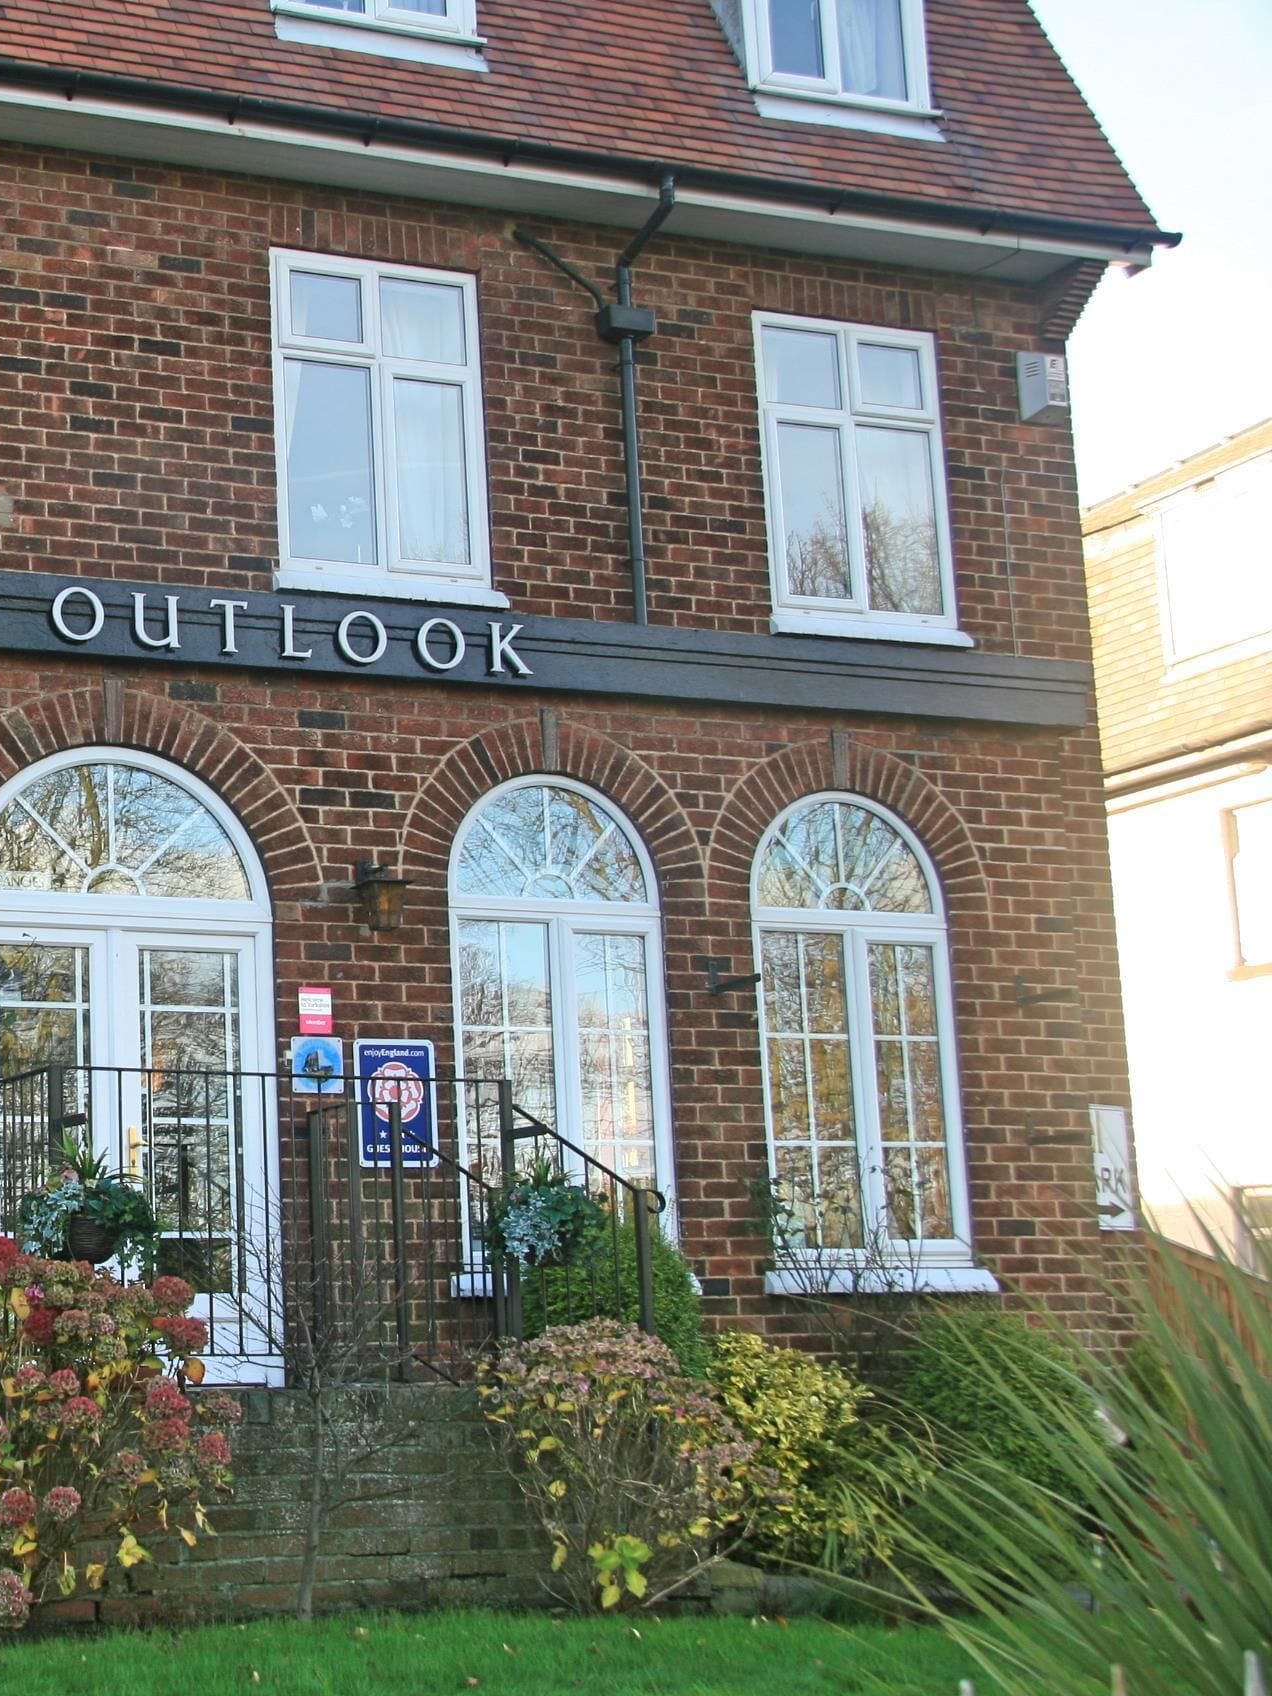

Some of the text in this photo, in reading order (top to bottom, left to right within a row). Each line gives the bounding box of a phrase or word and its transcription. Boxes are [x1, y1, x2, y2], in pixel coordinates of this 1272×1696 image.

[51, 586, 535, 675] OUTLOOK
[363, 1048, 425, 1058] enjoyEngland.com
[366, 1144, 396, 1153] GES
